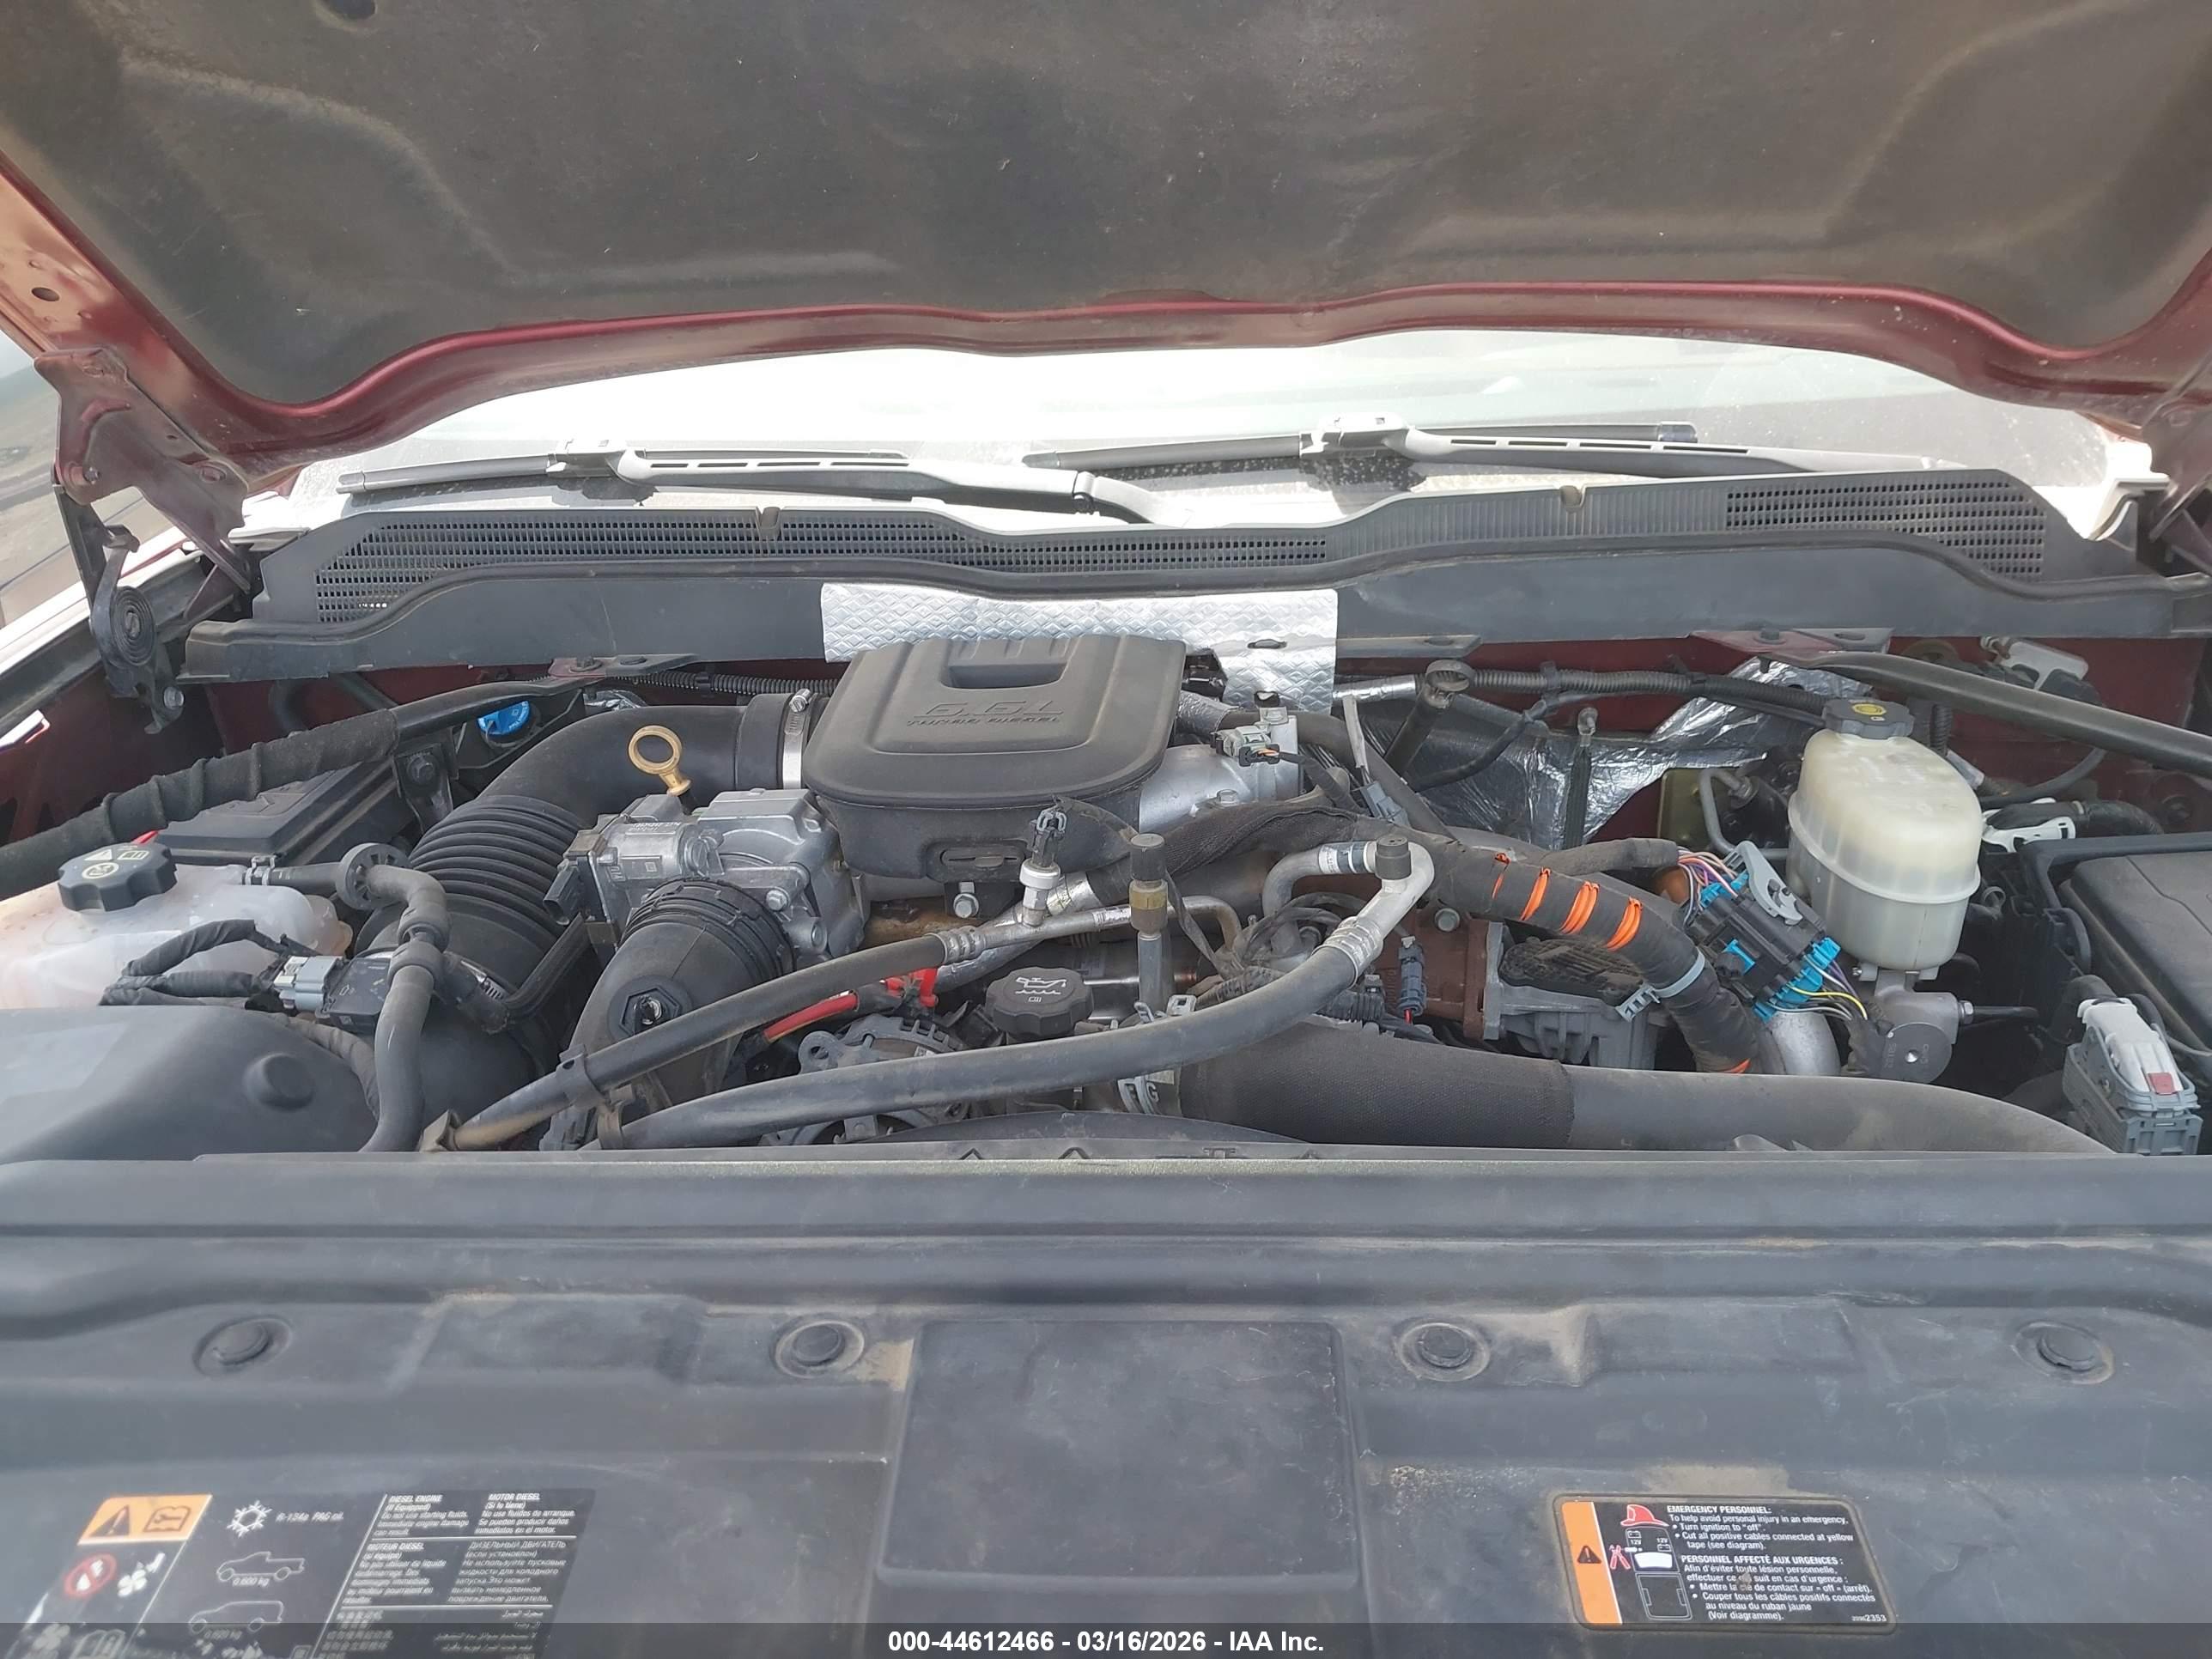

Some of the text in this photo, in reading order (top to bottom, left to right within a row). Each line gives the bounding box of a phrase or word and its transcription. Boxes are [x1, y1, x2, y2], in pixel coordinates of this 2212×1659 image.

[1719, 1505, 1772, 1514] PERSONNEL:
[1681, 1515, 1699, 1524] help
[1699, 1515, 1721, 1523] avoid
[1723, 1516, 1756, 1524] personal
[1757, 1516, 1779, 1525] injury
[1802, 1517, 1849, 1526] emergency.
[1700, 1523, 1731, 1532] ignition
[1710, 1532, 1742, 1541] positive
[1826, 1534, 1854, 1544] yellow
[1686, 1541, 1766, 1551] tape (see diagram).
[1680, 1555, 1732, 1564] PERSONNEL
[1733, 1554, 1771, 1565] AFFECTÉ
[1772, 1556, 1791, 1565] AUX
[1792, 1556, 1838, 1565] URGENCES
[1735, 1565, 1758, 1573] toute
[1759, 1565, 1784, 1573] lésion
[1753, 1583, 1765, 1592] de
[1702, 1593, 1734, 1602] Couper
[1769, 1593, 1798, 1601] câbles
[1799, 1594, 1831, 1603] positifs
[1832, 1594, 1876, 1602] connectés
[1760, 1602, 1788, 1611] ruban
[1788, 1602, 1812, 1613] jaune
[1708, 1611, 1784, 1621] (Voir diagramme).
